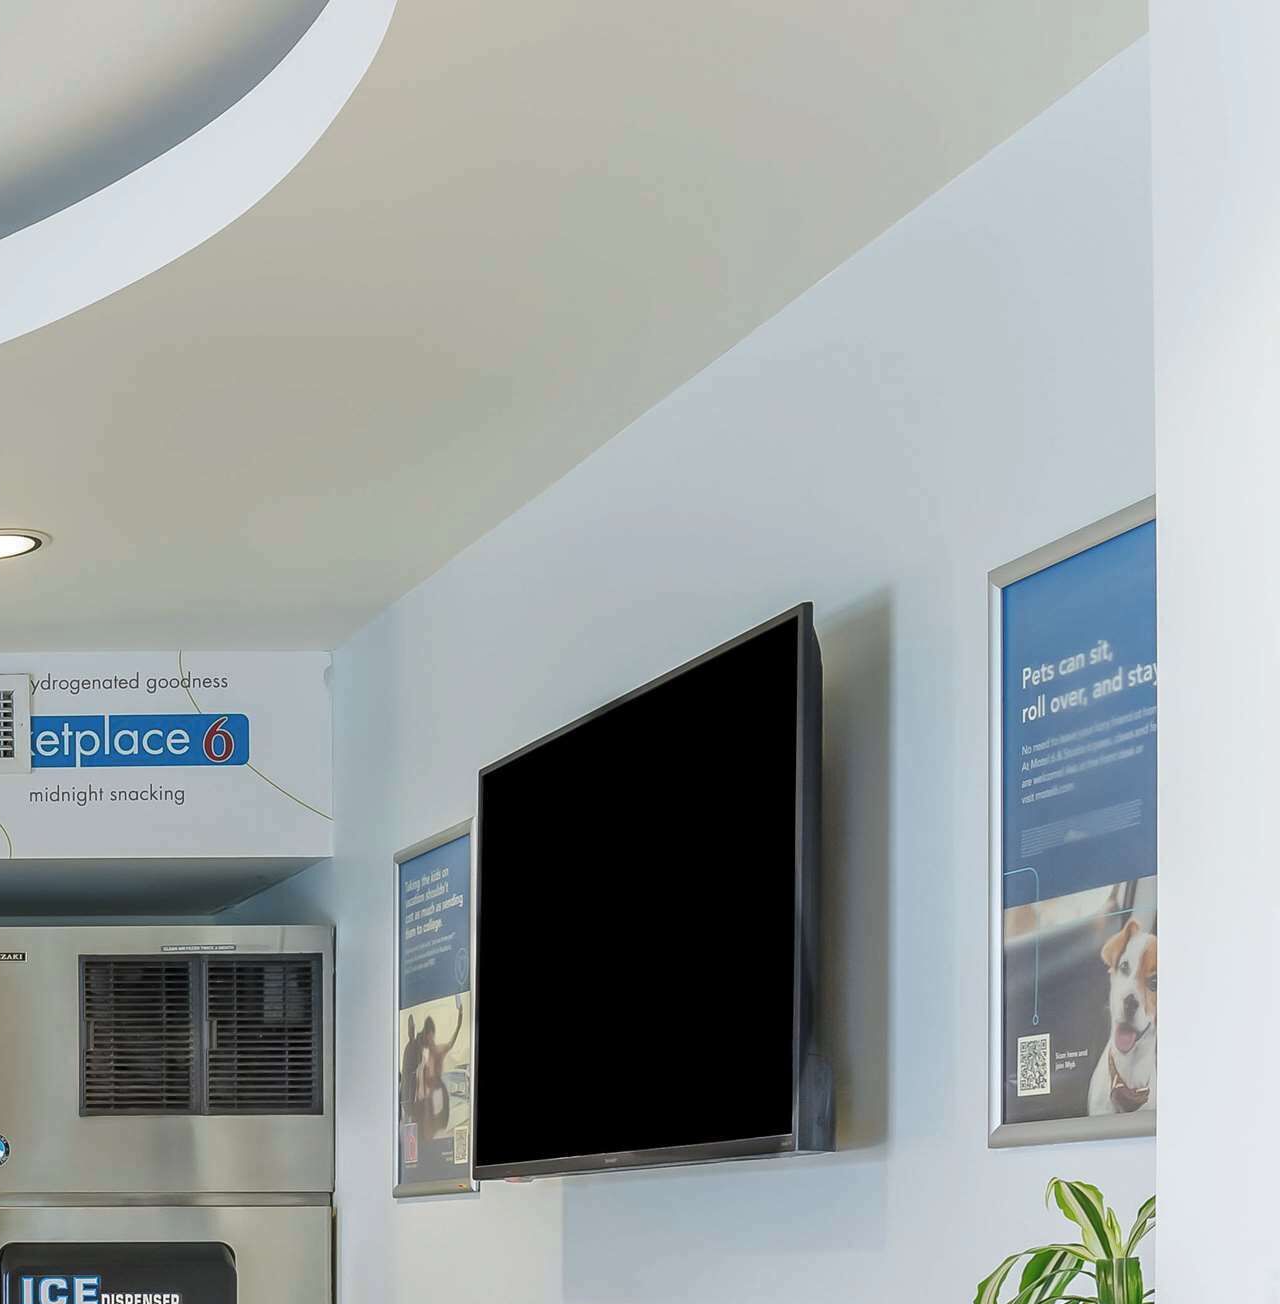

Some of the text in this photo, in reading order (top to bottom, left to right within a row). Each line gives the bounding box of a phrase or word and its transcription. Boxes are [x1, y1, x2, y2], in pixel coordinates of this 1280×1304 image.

[146, 671, 228, 693] goodness
[1022, 640, 1113, 689] Pets can sit,
[1022, 696, 1045, 723] roll
[1050, 687, 1088, 713] over,
[1092, 667, 1123, 699] and
[202, 716, 235, 763] 6
[29, 783, 185, 806] midnight snacking
